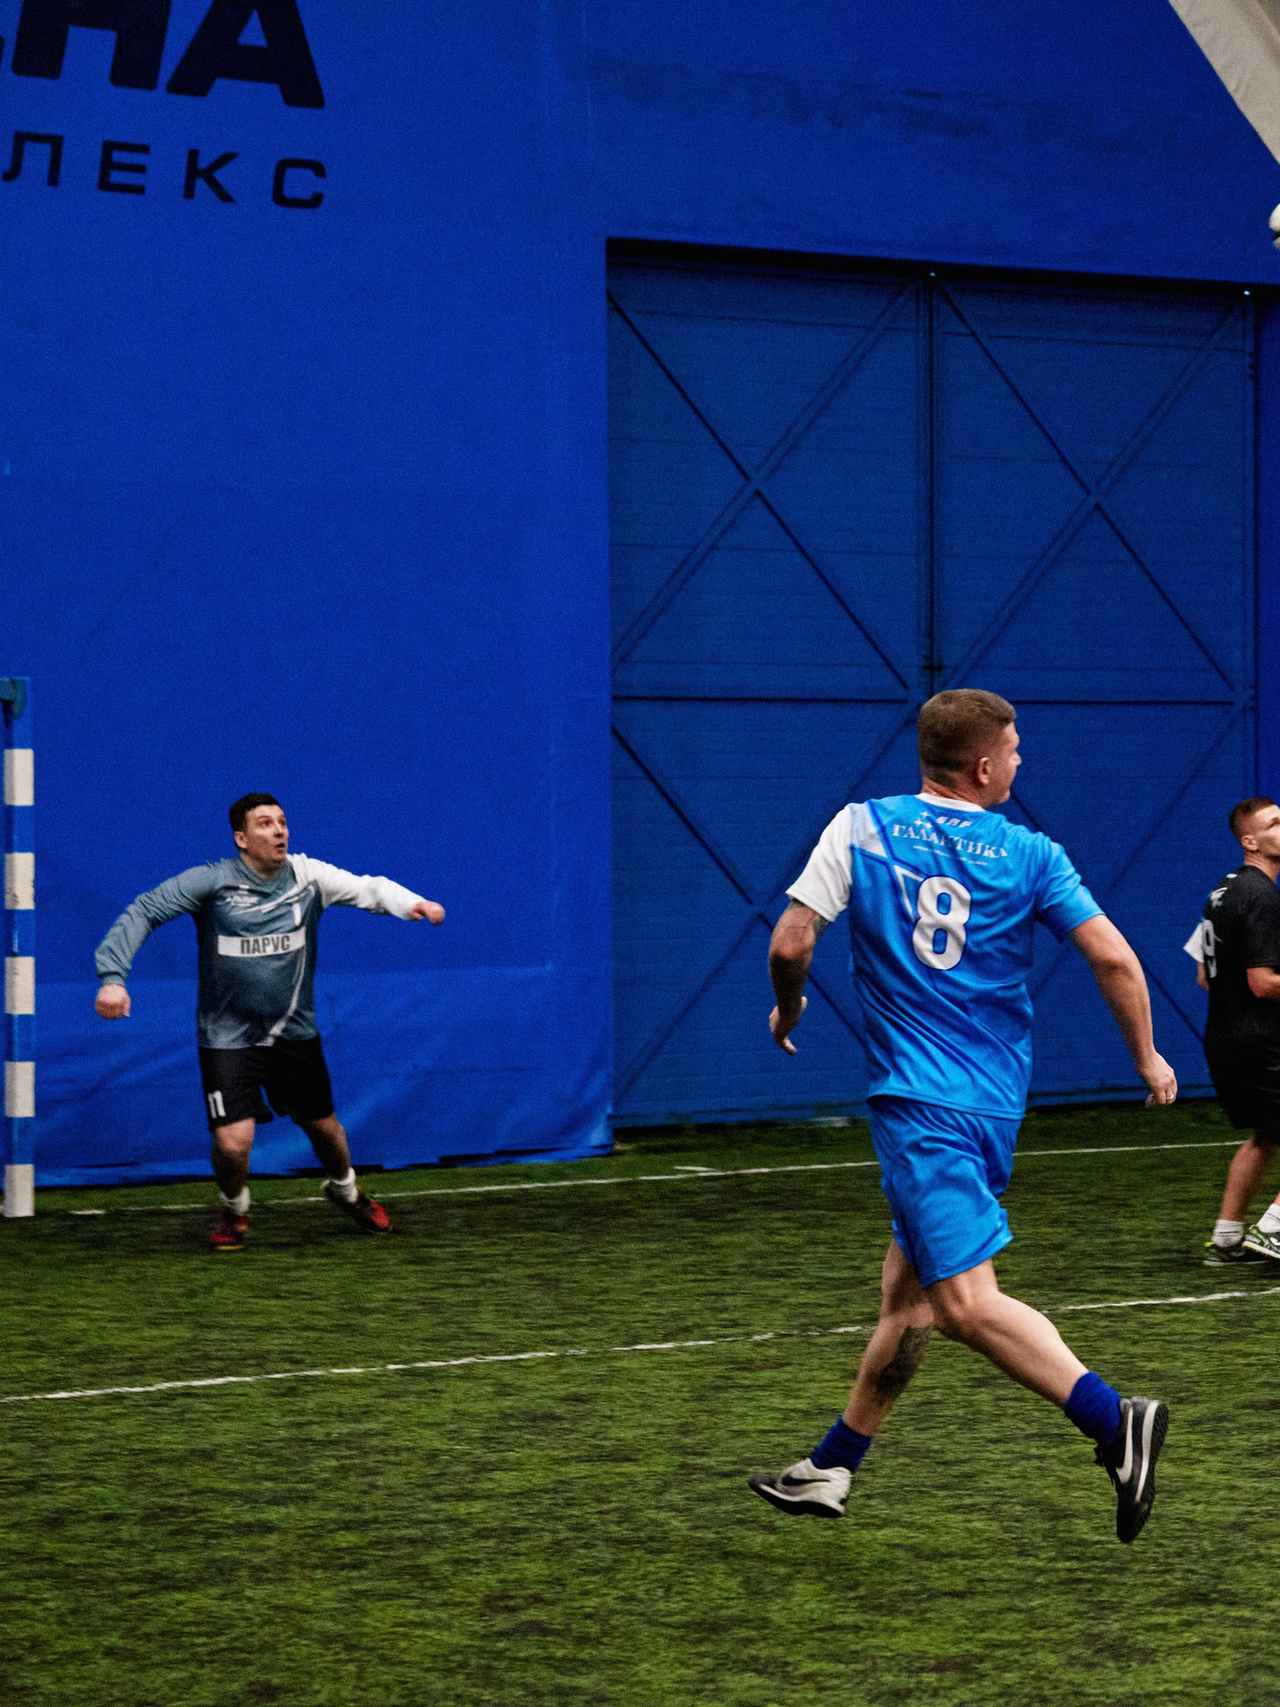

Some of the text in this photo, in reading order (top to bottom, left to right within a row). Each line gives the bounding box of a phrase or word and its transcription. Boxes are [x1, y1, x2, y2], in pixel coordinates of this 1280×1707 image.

[0, 0, 326, 109] НА
[2, 130, 327, 209] ЛЕКС
[240, 935, 291, 955] ПАРУС
[912, 875, 972, 970] 8
[207, 1090, 227, 1119] 11
